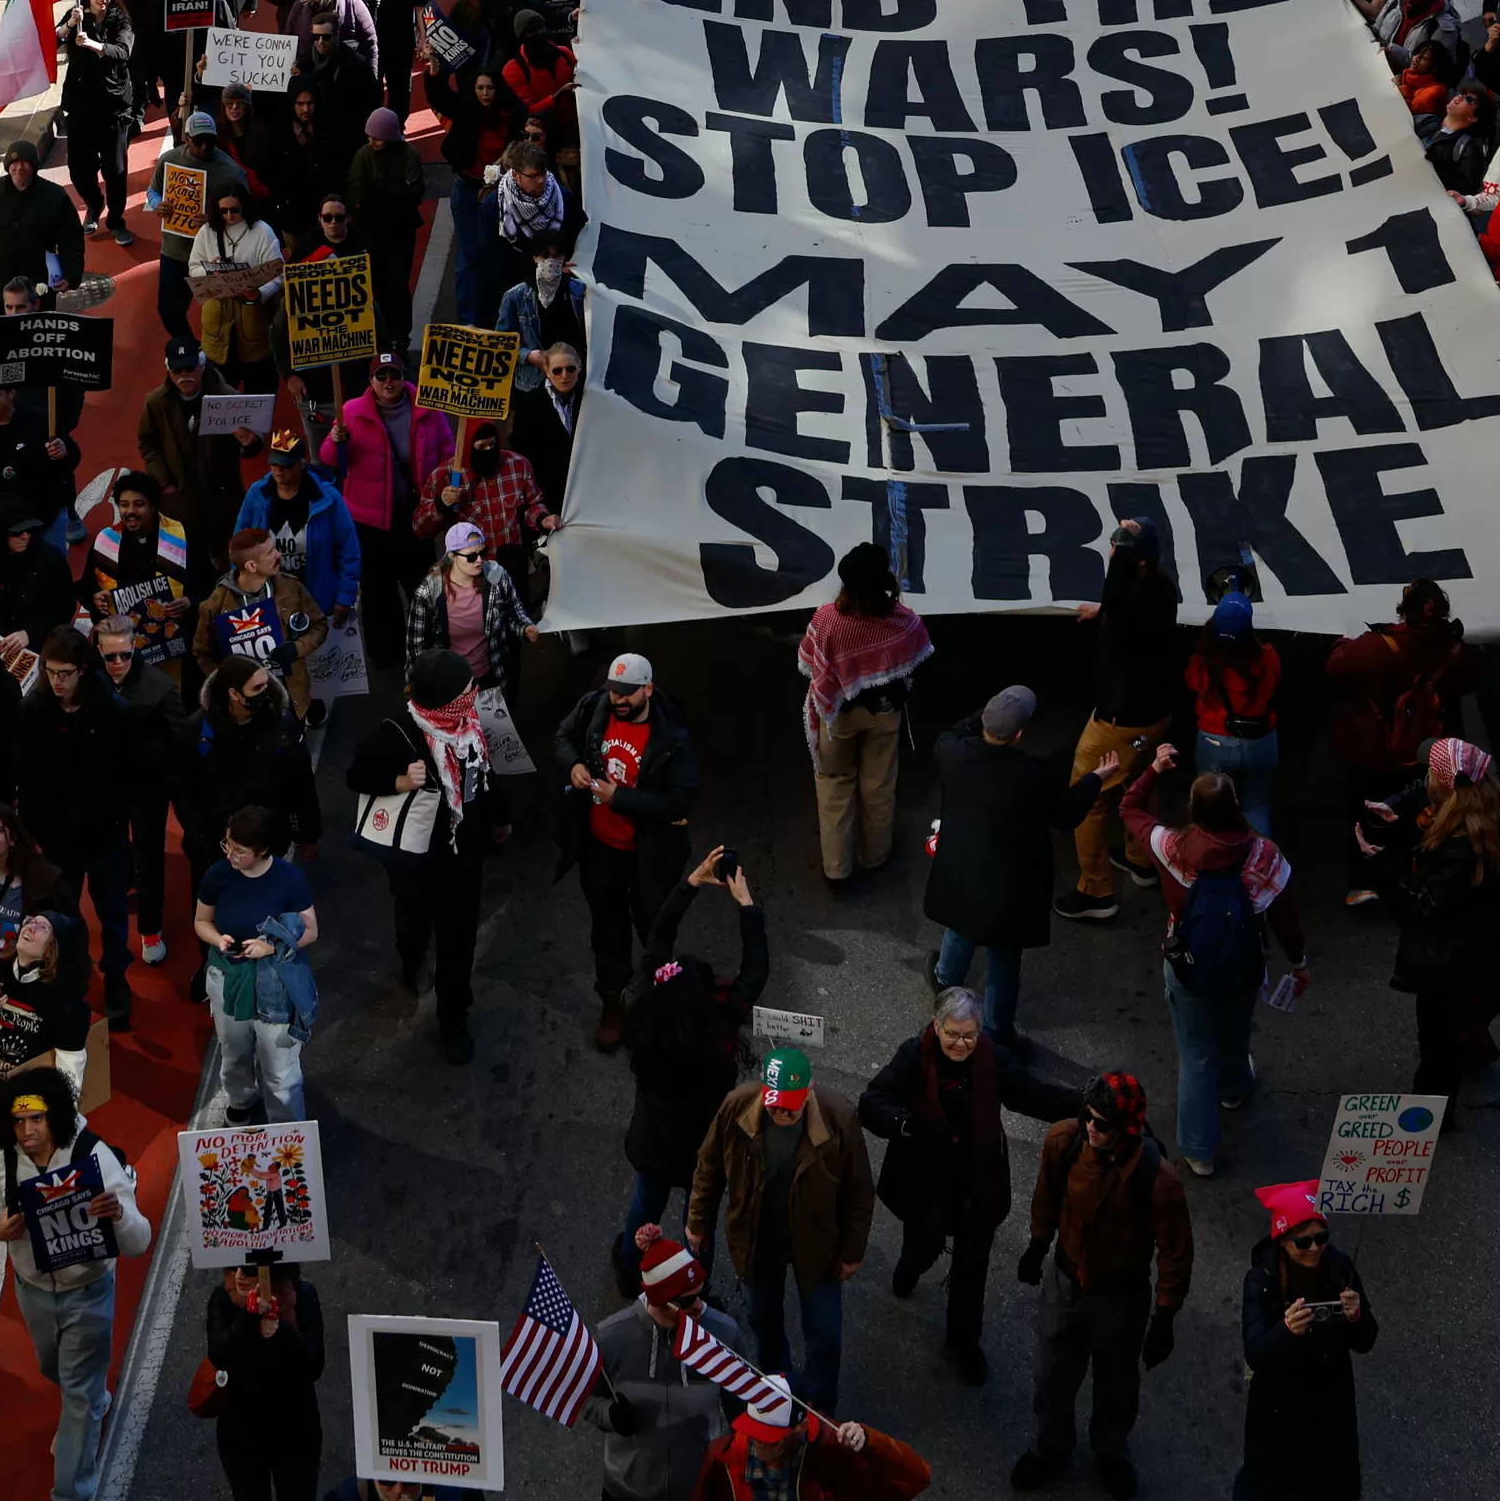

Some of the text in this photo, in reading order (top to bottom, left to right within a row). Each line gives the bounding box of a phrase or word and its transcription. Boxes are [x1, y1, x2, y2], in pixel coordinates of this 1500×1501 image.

[172, 1, 209, 12] IRAN!
[213, 33, 291, 50] WE'RE GONNA
[218, 51, 285, 68] GIT YOU
[230, 71, 284, 86] SUCKA!
[704, 20, 1250, 132] WARS!
[602, 94, 1393, 228] STOP ICE!
[591, 206, 1457, 341] MAY 1
[20, 319, 80, 331] HANDS
[33, 333, 66, 344] OFF
[6, 347, 96, 362] ABORTION
[699, 442, 1474, 609] STRIKE
[765, 1058, 783, 1105] MEXICO
[390, 1459, 470, 1476] NOT TRUMP
